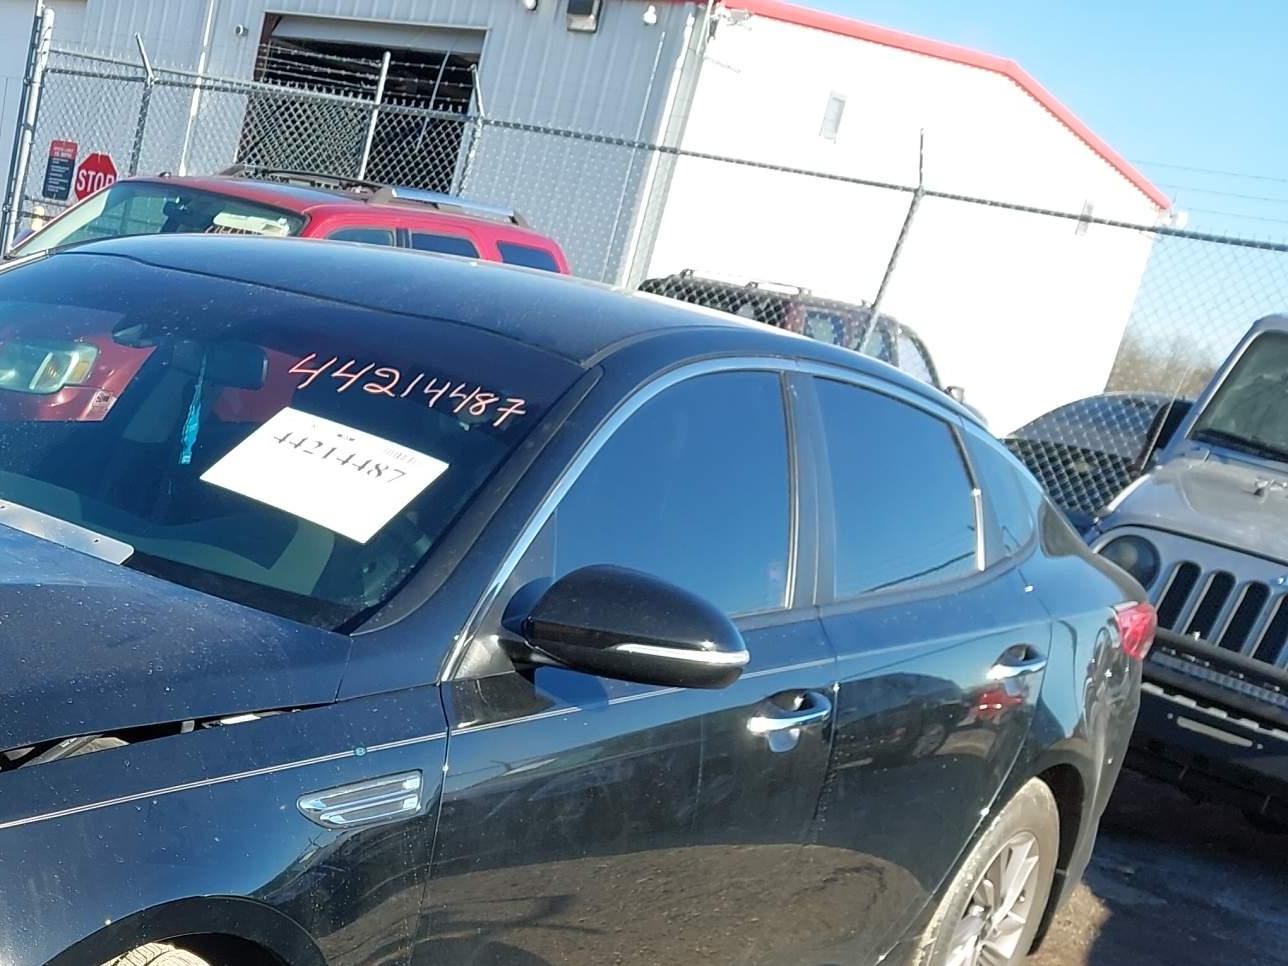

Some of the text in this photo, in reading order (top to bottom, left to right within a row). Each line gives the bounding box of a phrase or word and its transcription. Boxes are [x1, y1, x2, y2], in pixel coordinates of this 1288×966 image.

[76, 169, 115, 192] STOP
[288, 353, 526, 427] 44214487
[273, 432, 406, 483] 44214487
